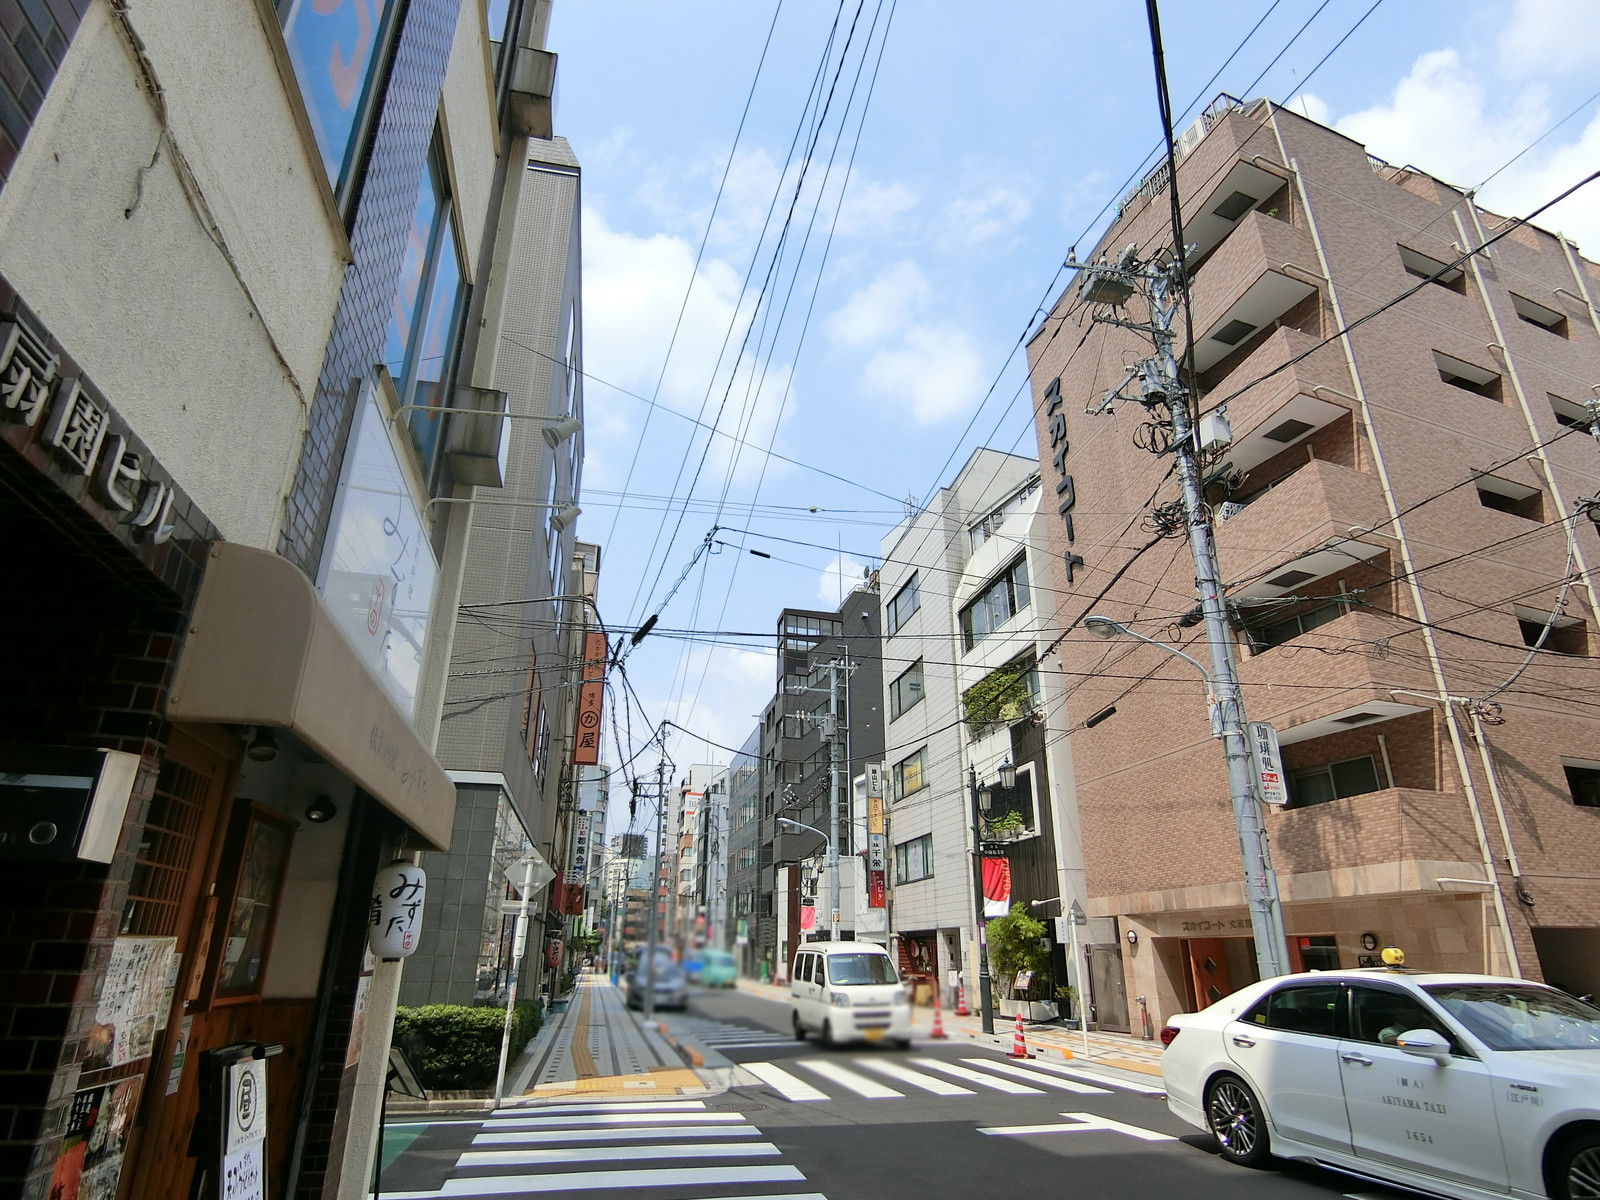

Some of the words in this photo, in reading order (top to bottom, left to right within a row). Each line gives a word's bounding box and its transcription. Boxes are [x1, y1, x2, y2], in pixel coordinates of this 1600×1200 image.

[1044, 376, 1084, 583] スカイコート
[385, 873, 424, 938] みずた
[1182, 920, 1225, 931] スカイコート
[1382, 1095, 1421, 1110] AKIYAMA
[1423, 1101, 1447, 1115] TAXI
[1406, 1129, 1434, 1144] 1654
